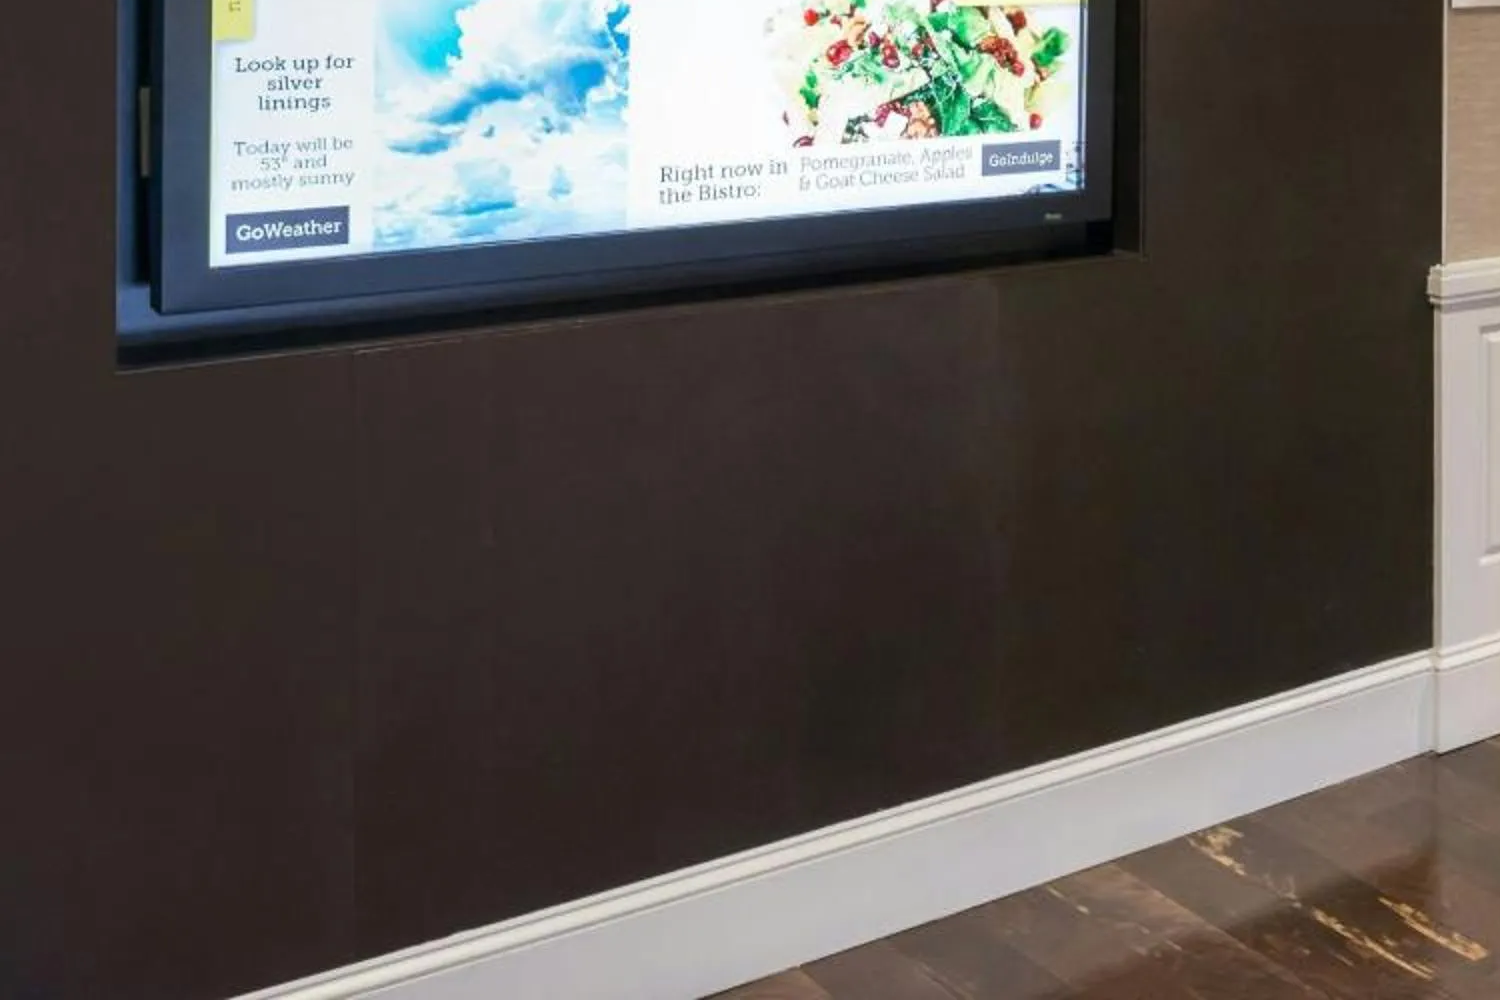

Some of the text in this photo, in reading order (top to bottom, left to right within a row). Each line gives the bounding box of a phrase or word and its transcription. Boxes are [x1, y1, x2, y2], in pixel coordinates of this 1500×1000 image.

[234, 54, 355, 77] Look up for
[267, 75, 323, 92] silver
[258, 94, 331, 113] linings
[233, 136, 353, 158] Today will be
[294, 154, 327, 169] and
[659, 158, 788, 186] Right now in
[231, 171, 355, 193] mostly sunny
[815, 170, 854, 191] Goat
[858, 167, 920, 187] Cheese
[923, 163, 966, 184] Salad
[658, 182, 761, 205] the Bistro:
[235, 217, 341, 241] GoWeather
